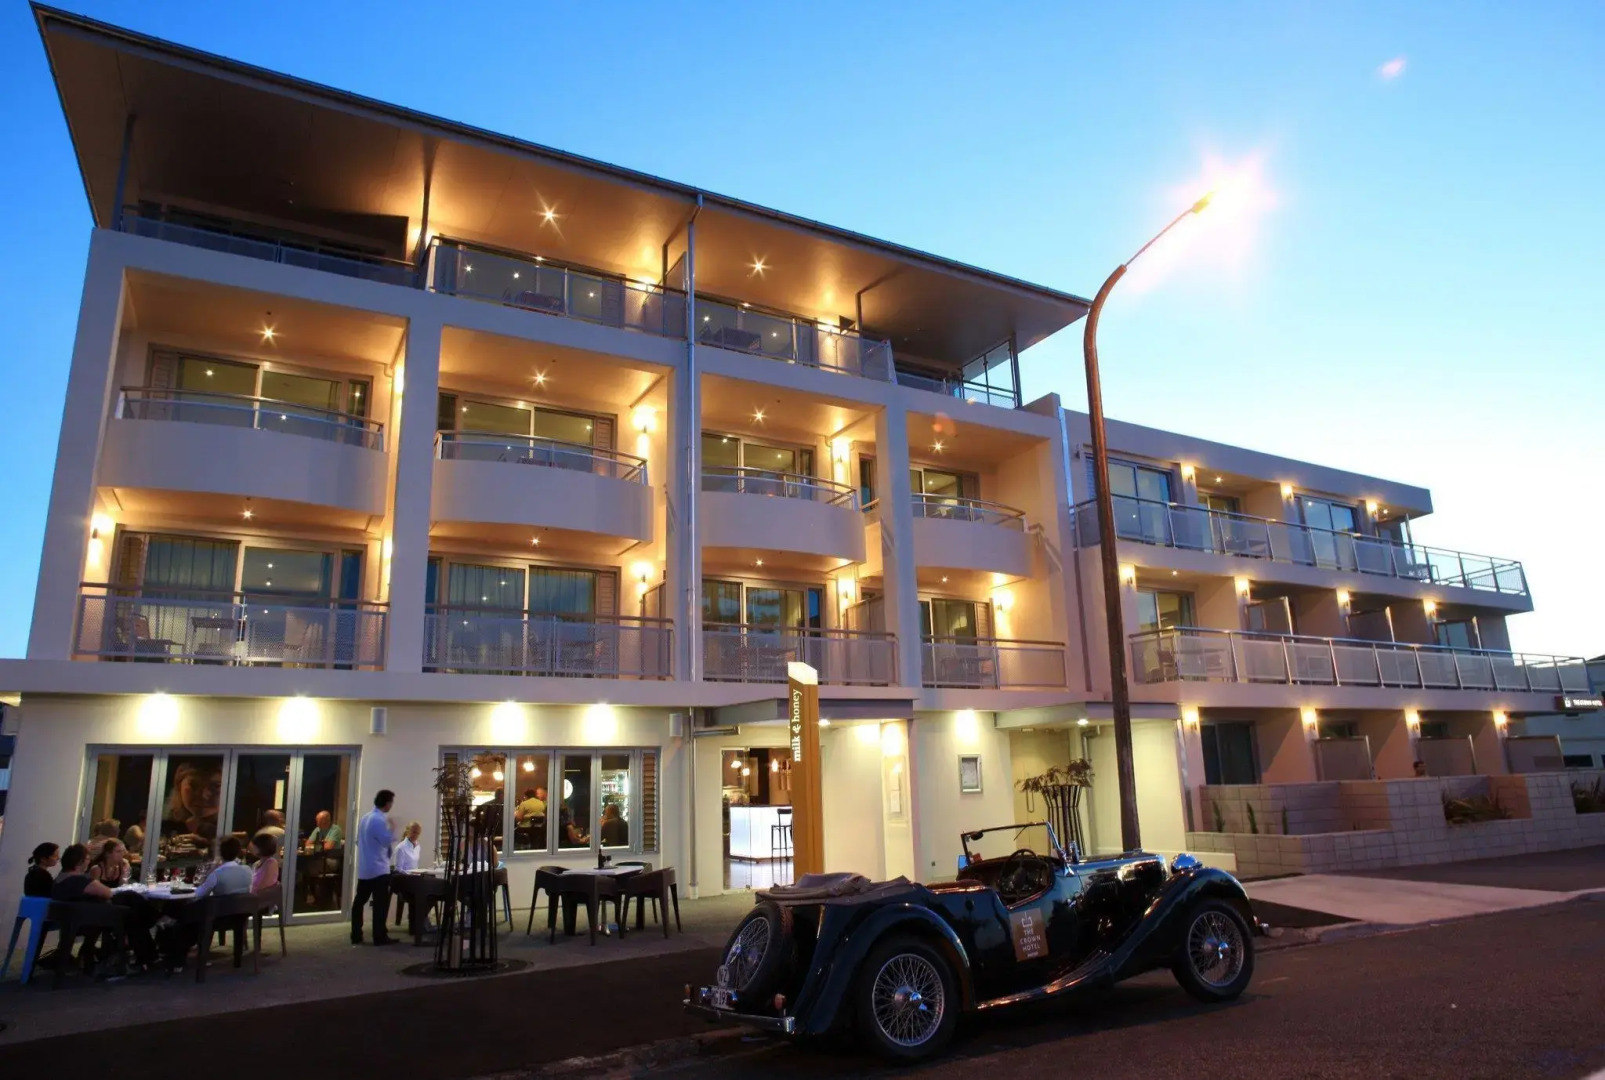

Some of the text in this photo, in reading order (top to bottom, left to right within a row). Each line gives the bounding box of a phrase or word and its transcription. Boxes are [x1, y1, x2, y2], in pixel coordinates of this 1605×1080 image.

[792, 688, 803, 762] milk & honey
[1023, 927, 1034, 936] THE
[1019, 934, 1041, 945] CROWN
[1022, 942, 1041, 953] HOTEL
